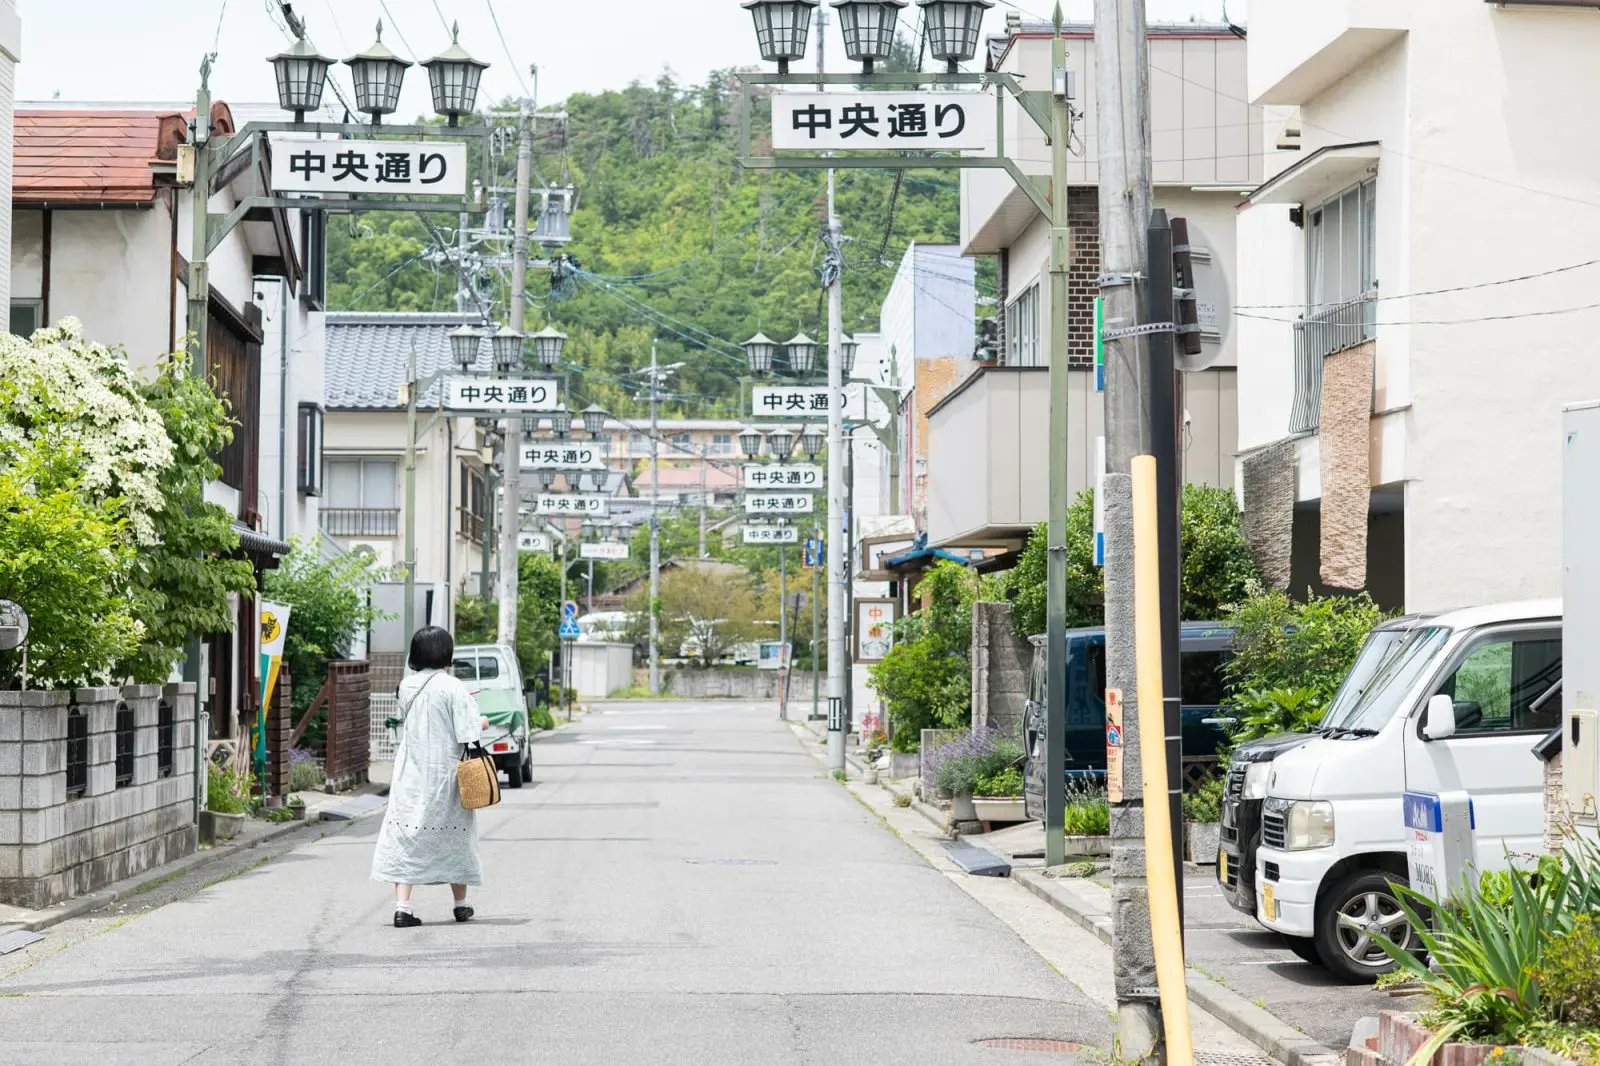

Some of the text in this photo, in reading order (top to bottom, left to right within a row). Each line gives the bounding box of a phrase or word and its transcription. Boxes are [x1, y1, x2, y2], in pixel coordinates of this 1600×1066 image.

[791, 102, 966, 139] 中央通り
[289, 150, 447, 185] 中央通り
[460, 385, 547, 404] 中央通り
[525, 449, 593, 463] 中央通り
[752, 471, 816, 485] 中央通り
[542, 499, 600, 511] 中央通り
[752, 497, 808, 509] 中央通り
[749, 529, 793, 540] 中央通り
